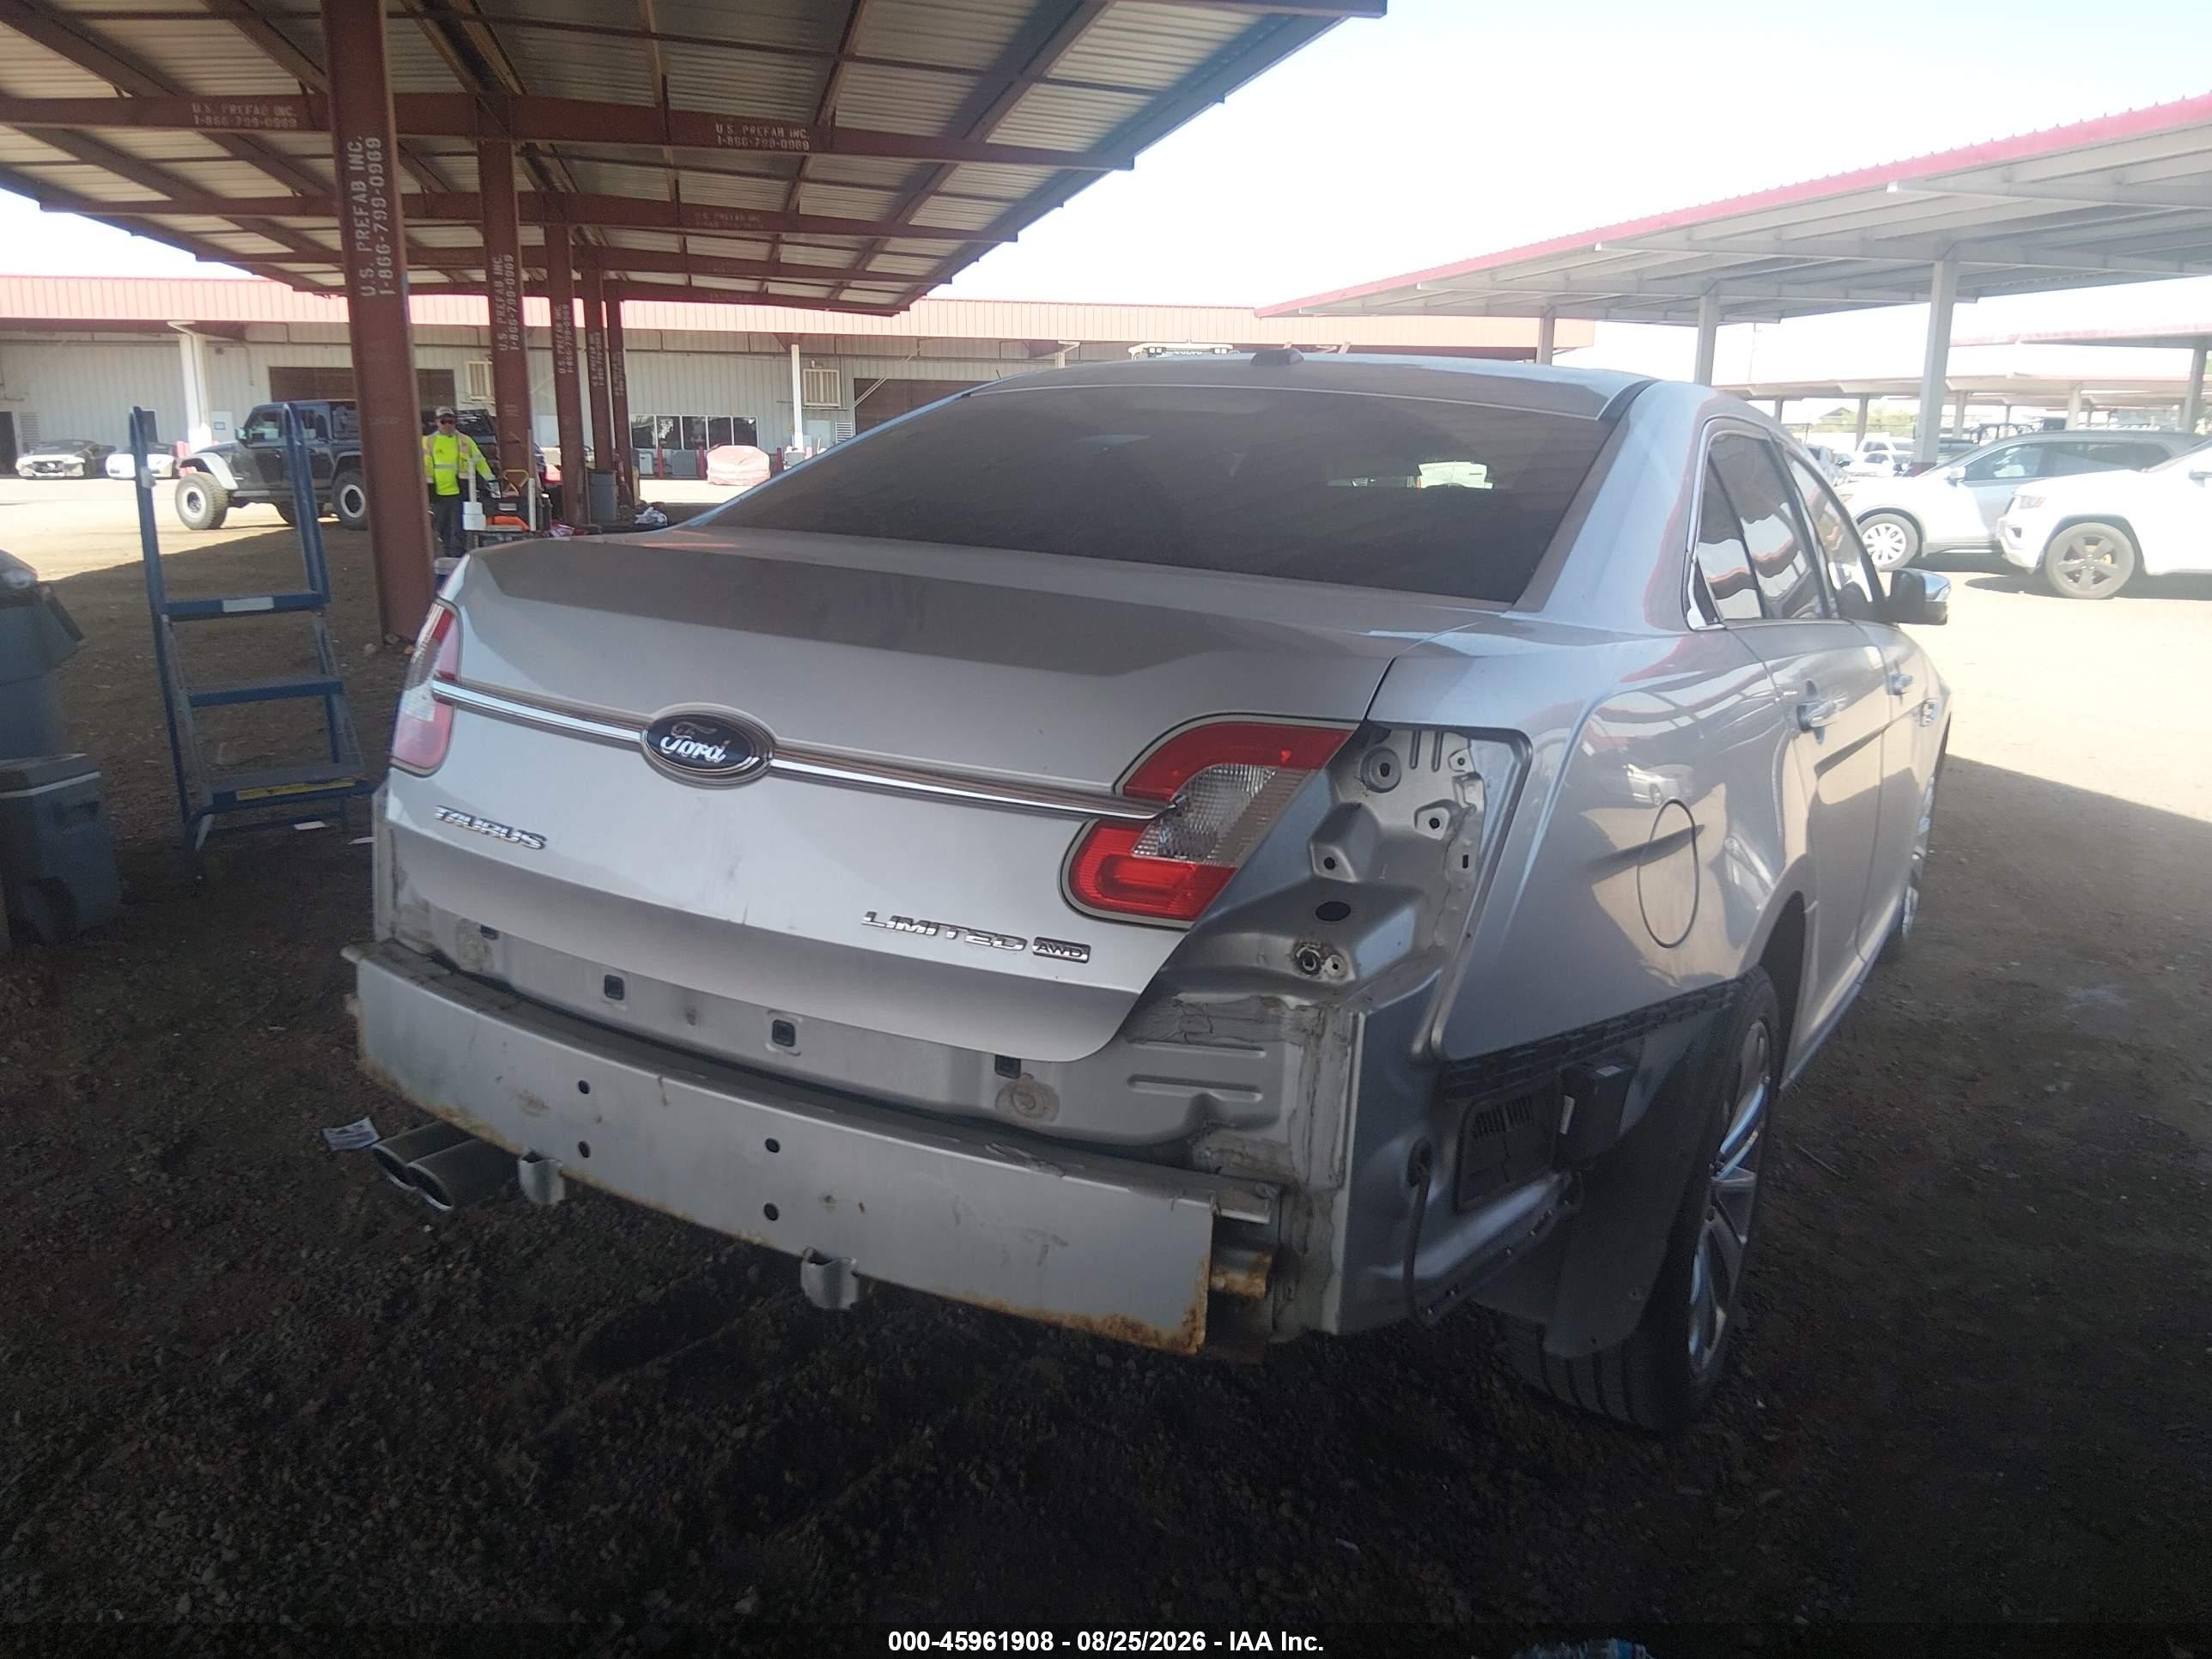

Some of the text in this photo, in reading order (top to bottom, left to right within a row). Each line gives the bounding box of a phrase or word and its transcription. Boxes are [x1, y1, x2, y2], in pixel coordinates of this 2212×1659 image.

[742, 124, 785, 137] PREFAB
[347, 136, 377, 297] U.S. PREFAB INC.
[365, 137, 396, 295] 1-866-799-0969
[494, 280, 507, 324] PREFAB
[659, 721, 731, 763] Ford
[434, 805, 547, 850] TAURUS
[860, 910, 1085, 959] LIMITED AWD
